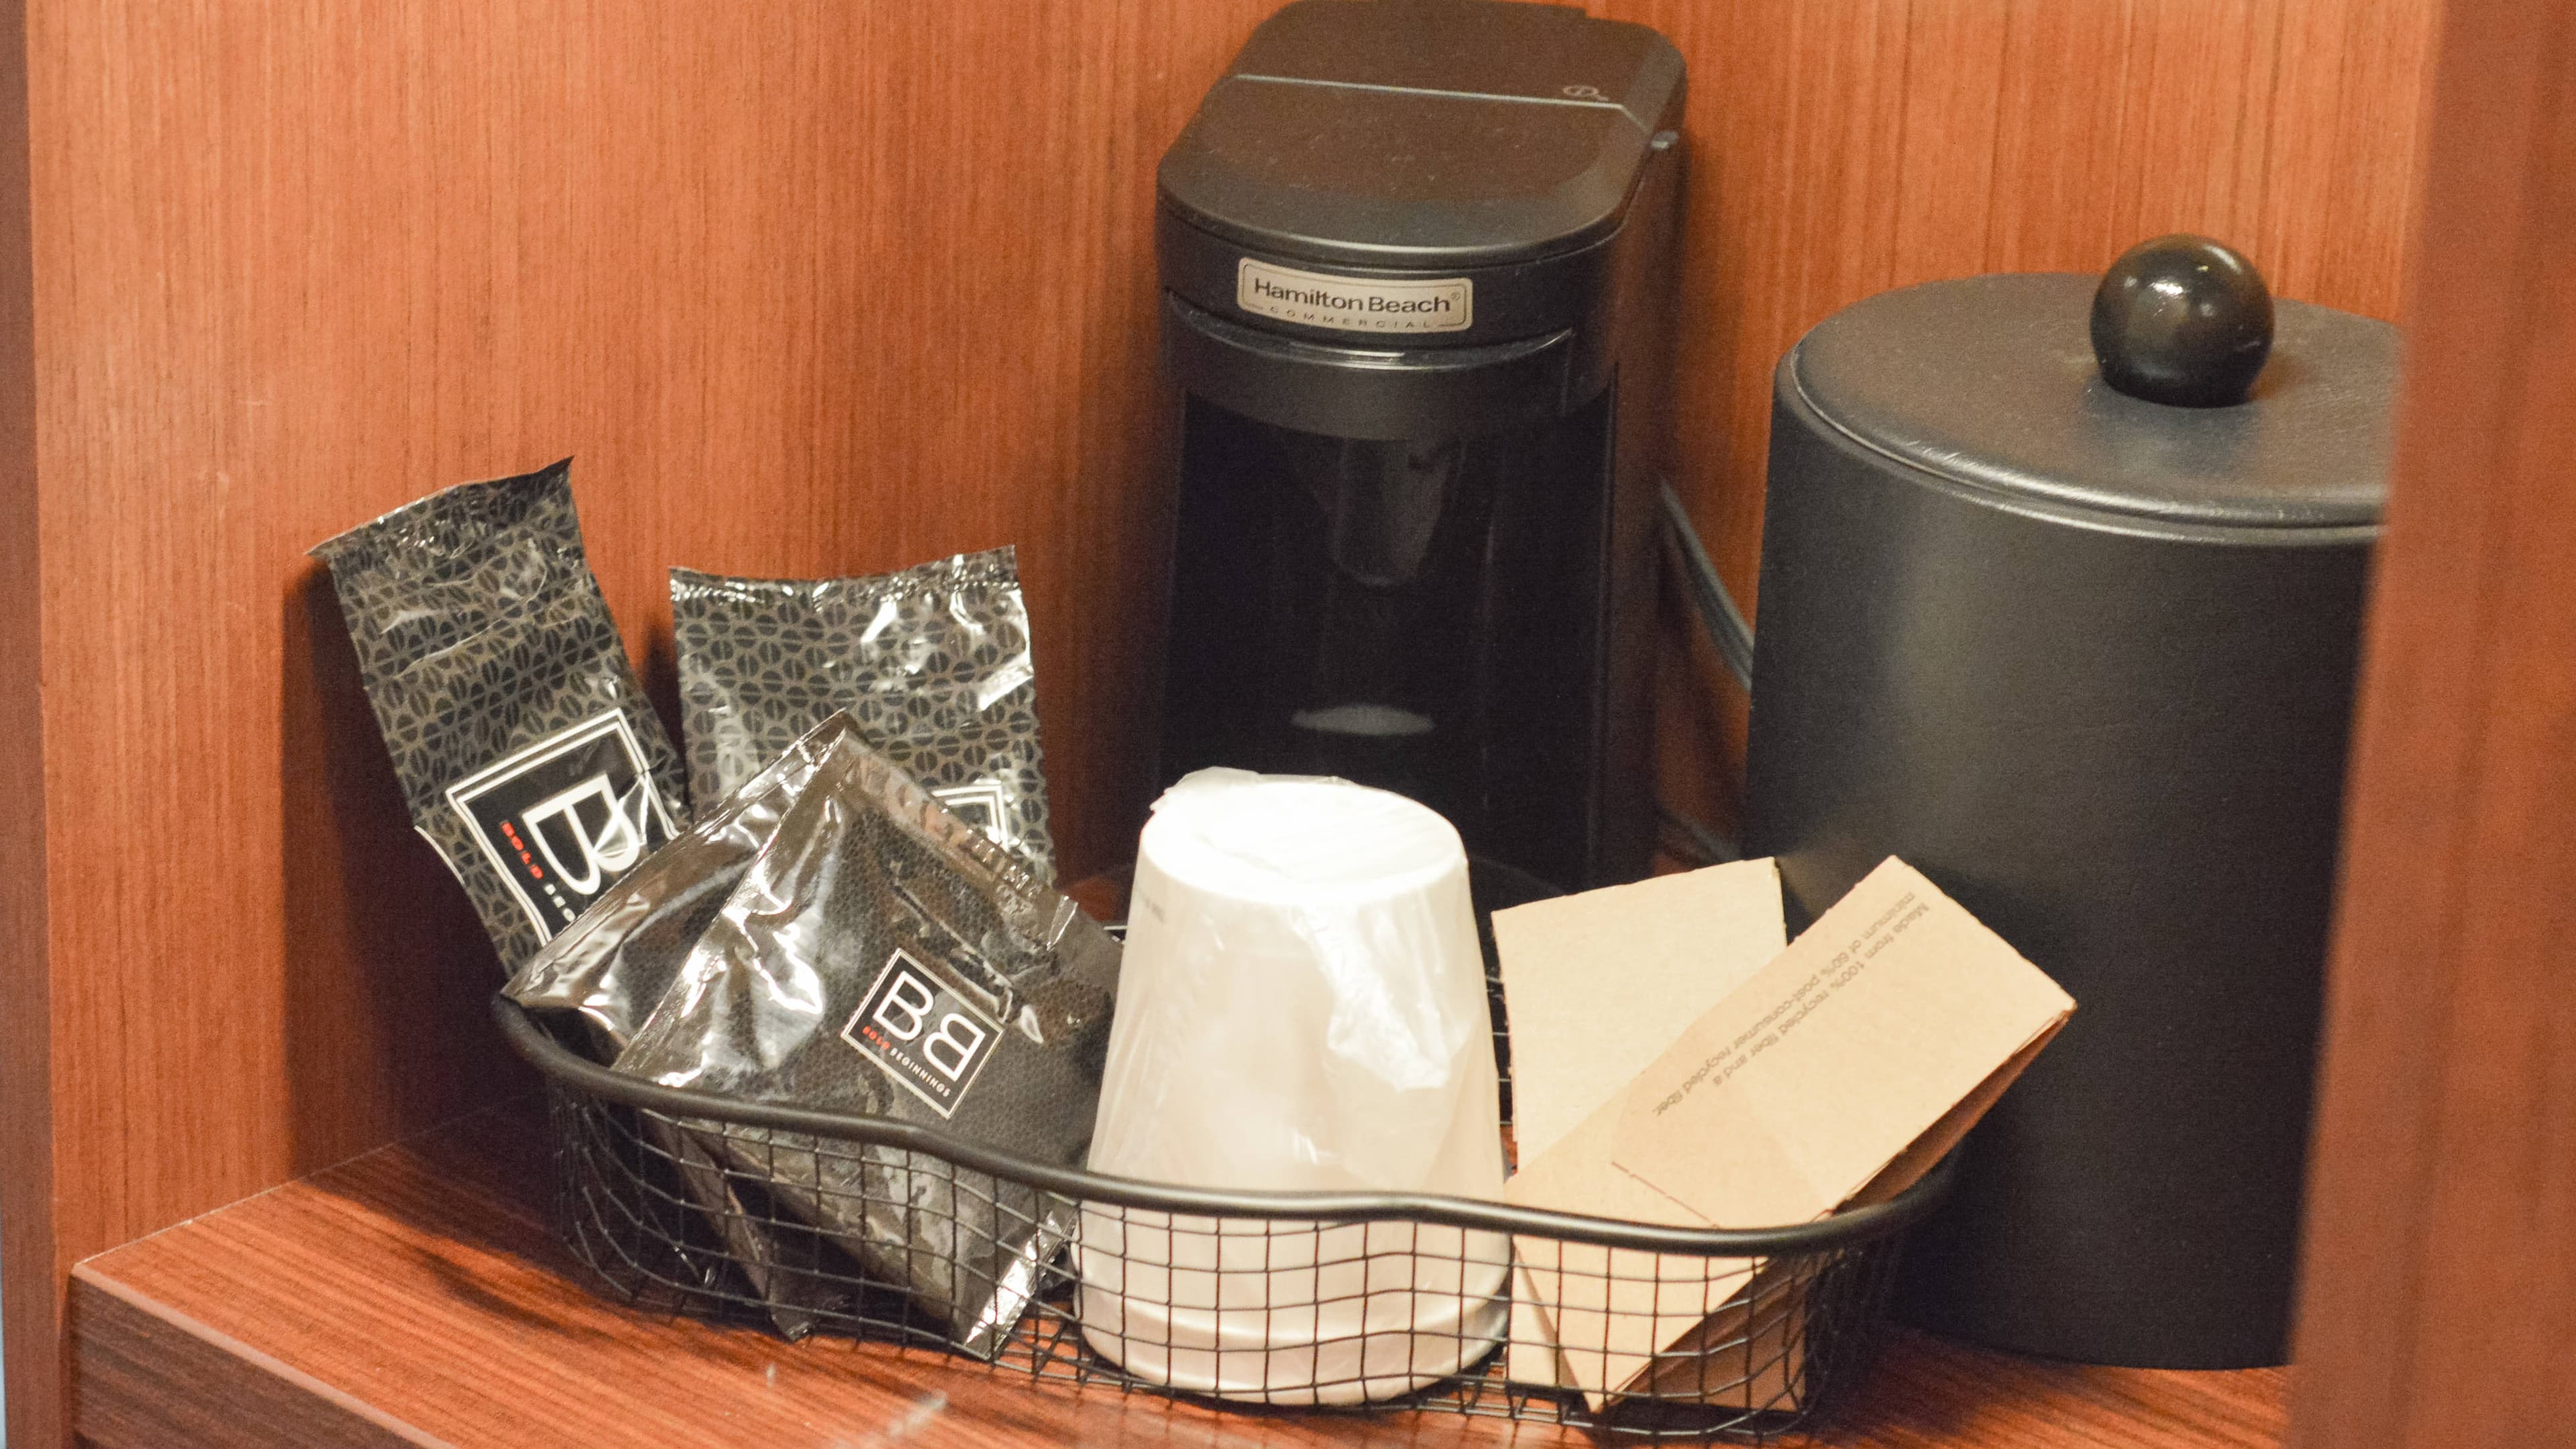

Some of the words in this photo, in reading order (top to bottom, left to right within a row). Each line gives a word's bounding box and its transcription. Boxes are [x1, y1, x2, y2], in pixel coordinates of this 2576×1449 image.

[1254, 277, 1364, 311] Hamilton
[1269, 305, 1434, 329] COMMERCIAL
[500, 820, 544, 880] BOLD
[1861, 891, 1915, 940] minimum
[1892, 902, 1930, 934] Made
[1848, 939, 1863, 954] of
[1863, 932, 1894, 959] from
[1820, 951, 1849, 977] 60%
[1829, 961, 1865, 989] 100%
[1733, 973, 1821, 1049] post-consumer
[1778, 989, 1829, 1036] recycled
[1750, 1032, 1779, 1057] fiber
[861, 1025, 892, 1051] BOLD
[889, 1046, 951, 1098] BEGINNINGS
[1682, 1046, 1731, 1094] recycled
[1723, 1054, 1748, 1079] and
[1712, 1075, 1723, 1087] a
[1652, 1089, 1684, 1117] fiber.
